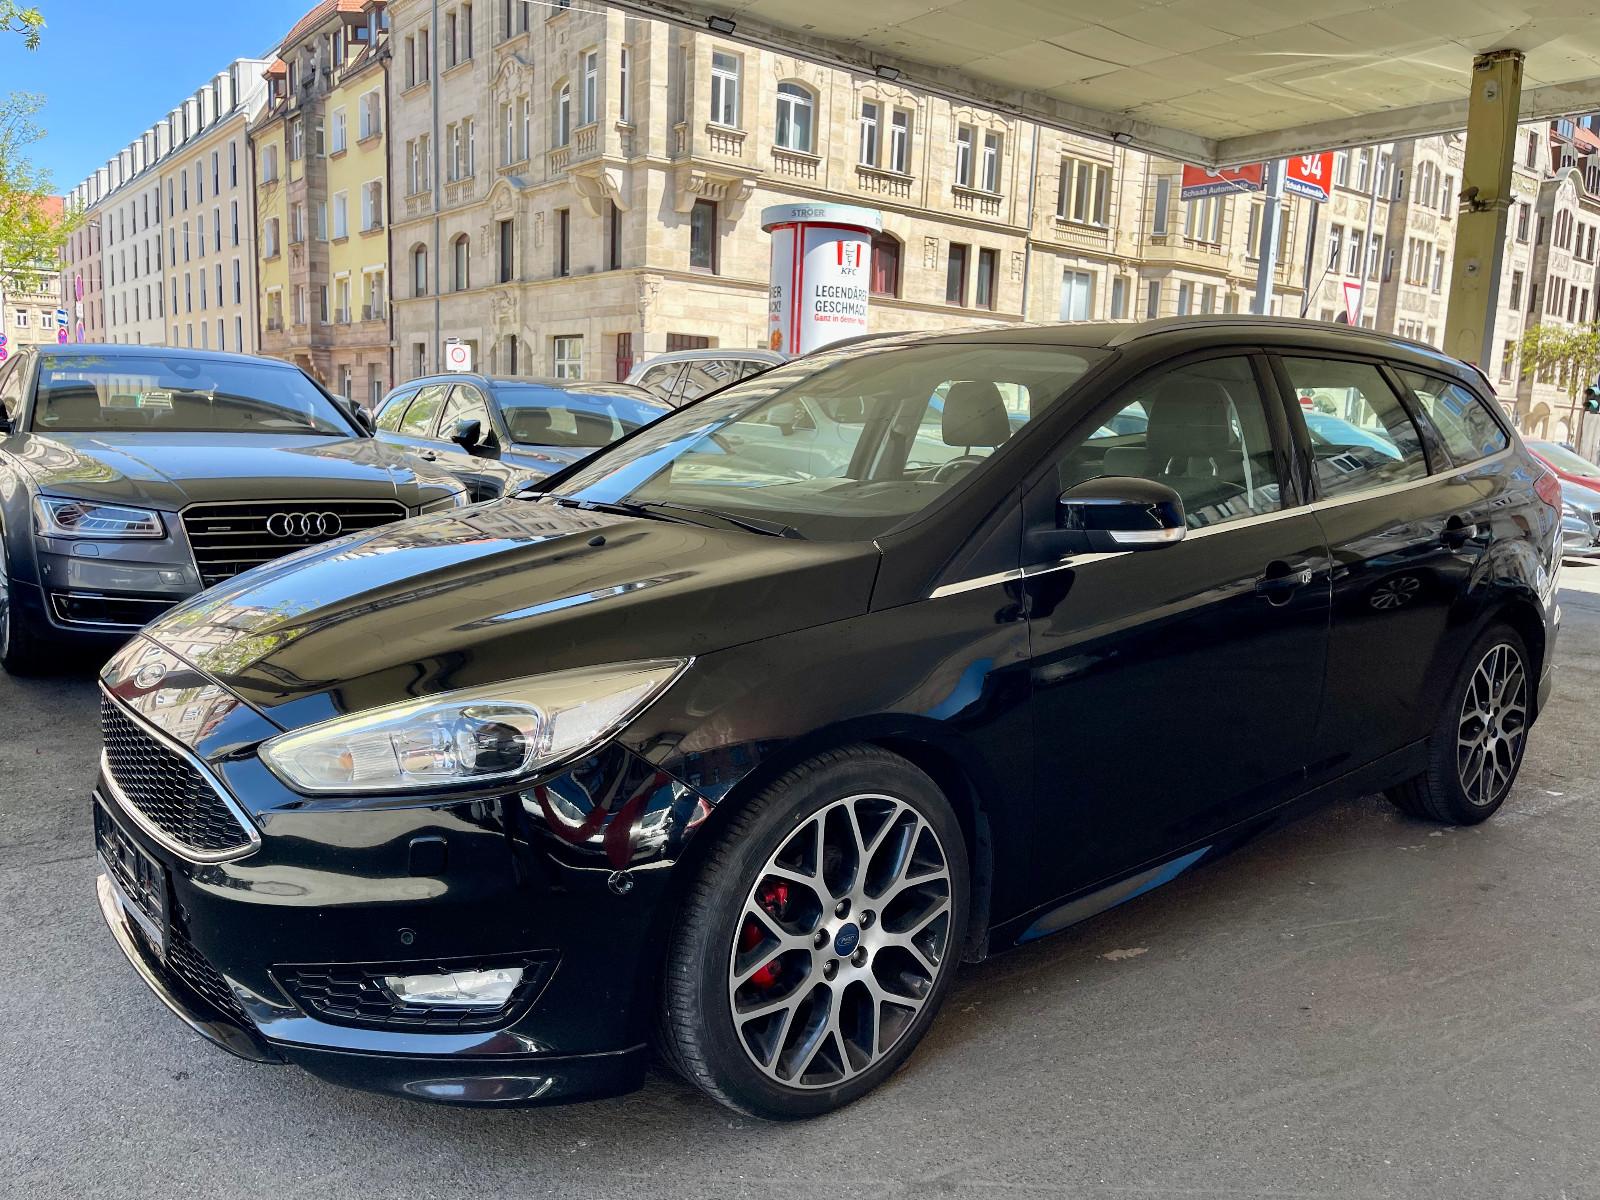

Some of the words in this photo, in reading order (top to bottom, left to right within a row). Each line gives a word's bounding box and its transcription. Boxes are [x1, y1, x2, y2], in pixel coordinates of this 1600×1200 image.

[1301, 153, 1322, 180] 94
[841, 267, 857, 276] KFC
[832, 313, 839, 322] in
